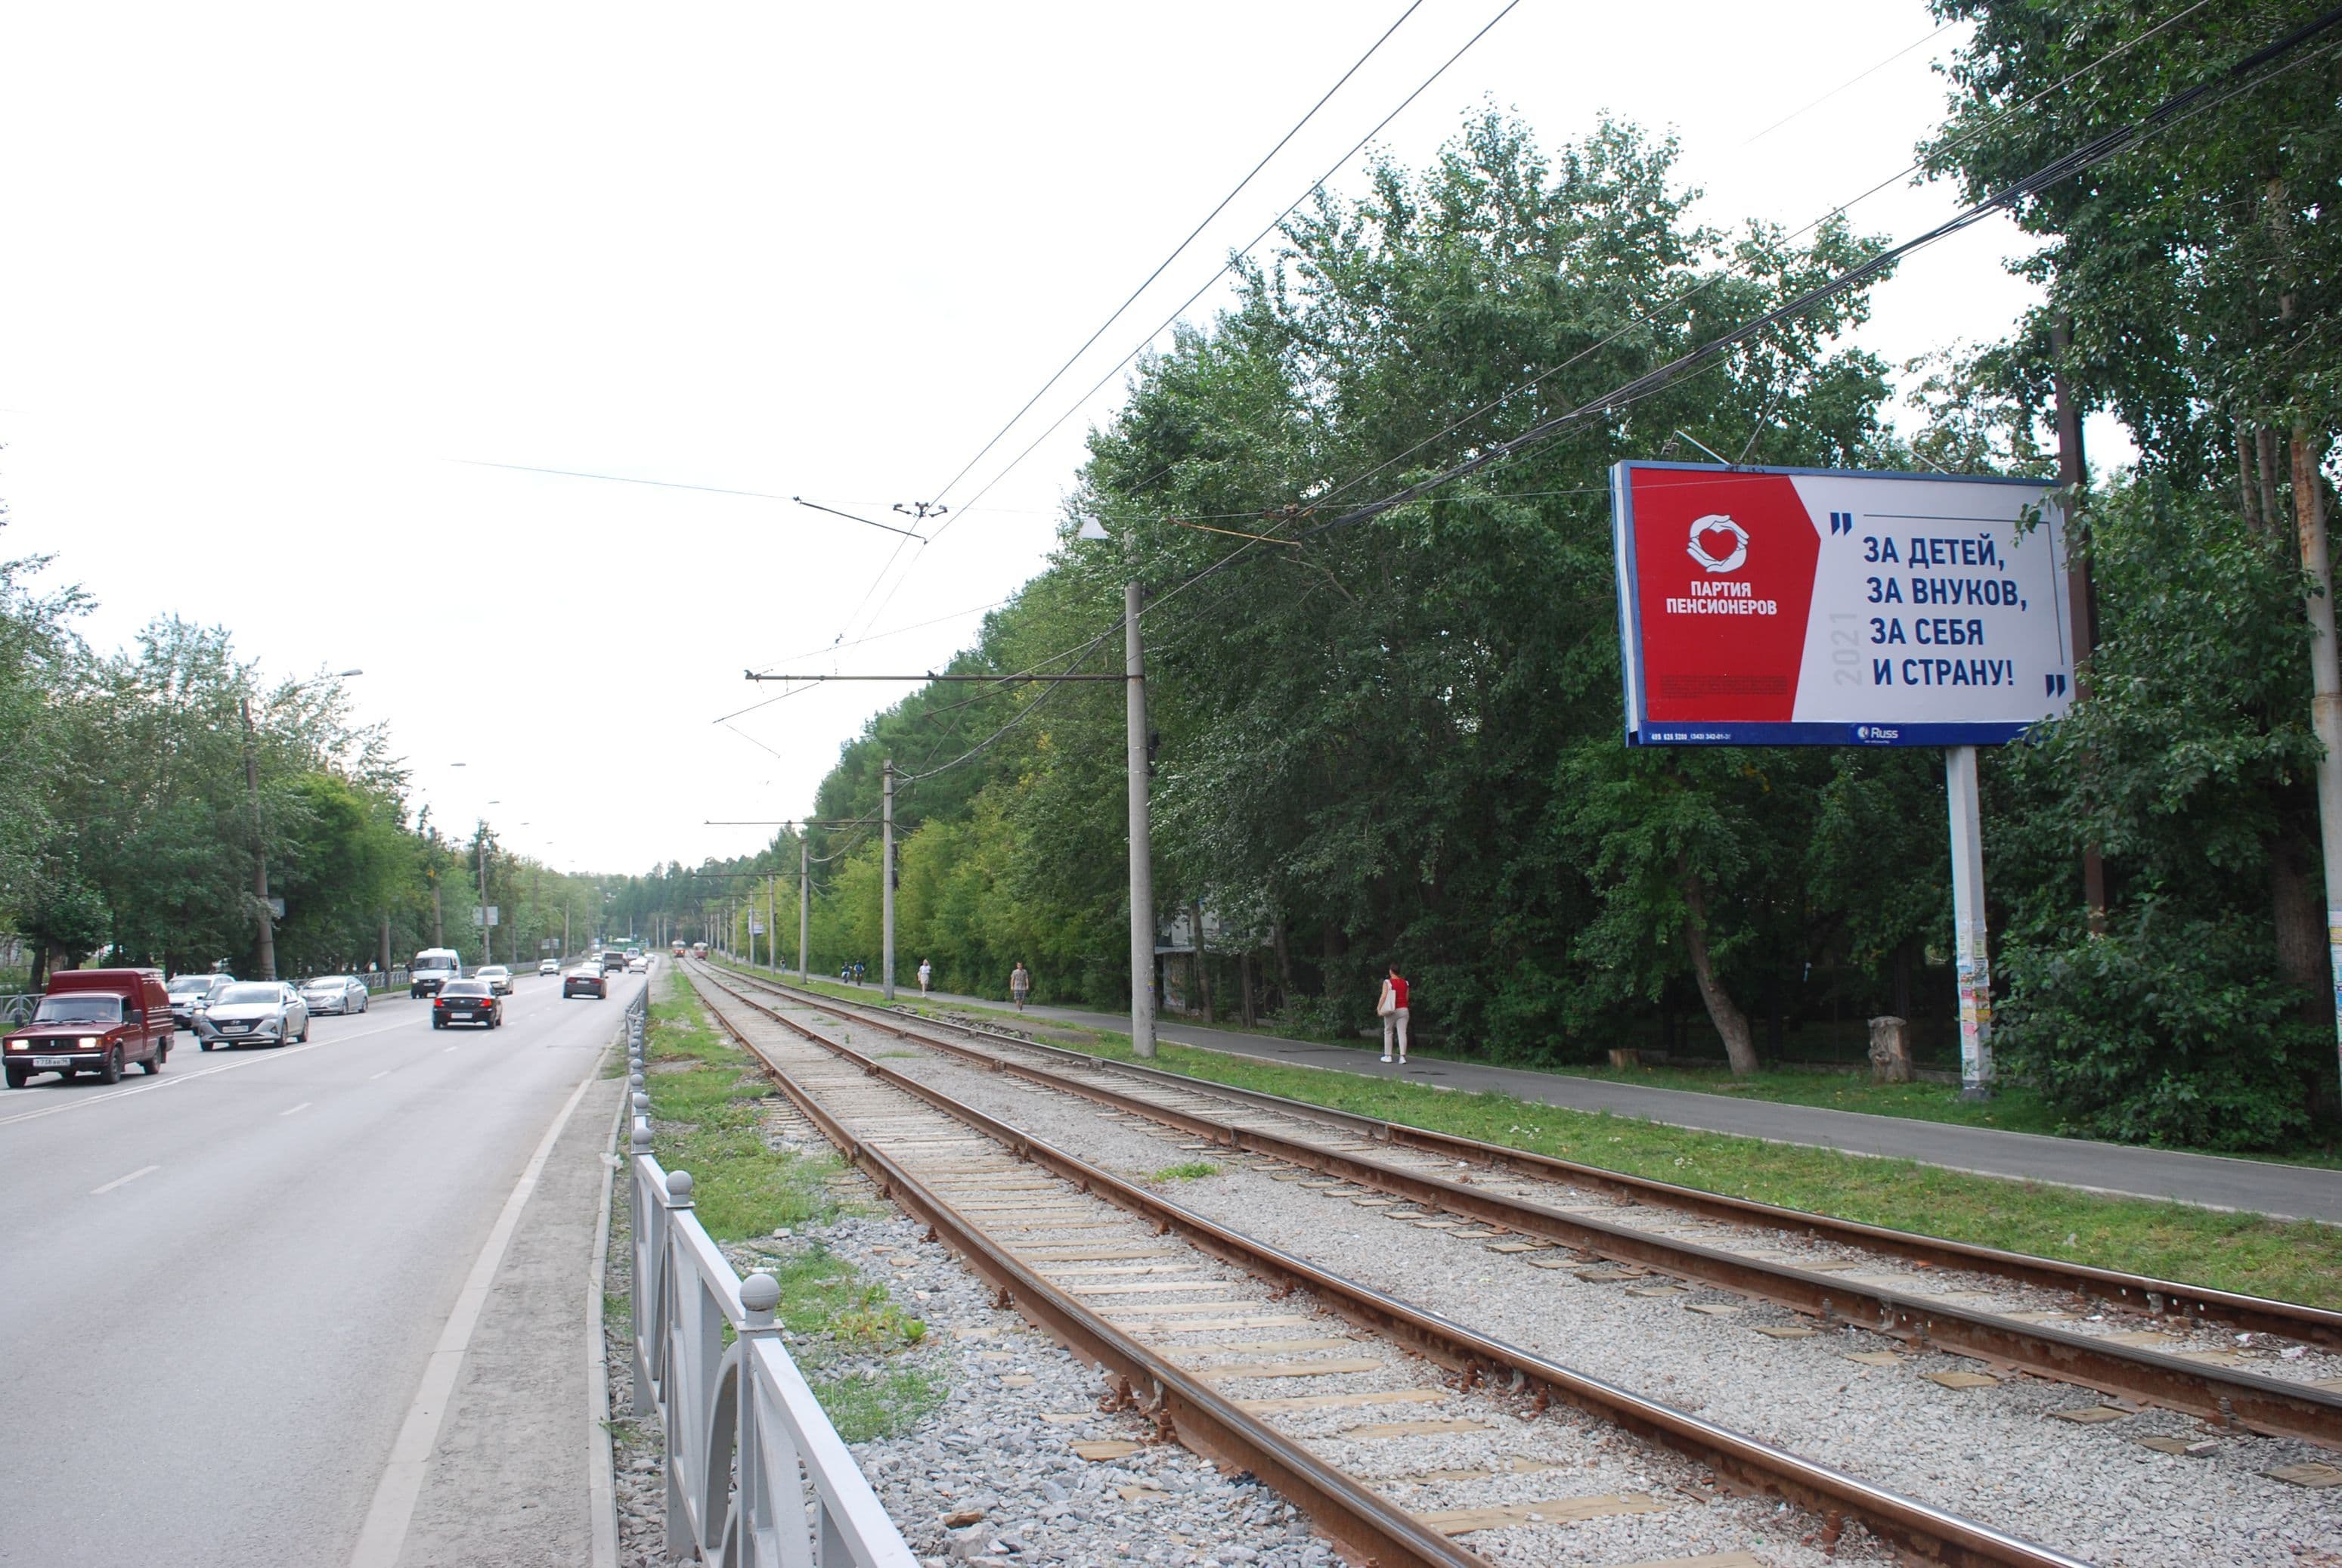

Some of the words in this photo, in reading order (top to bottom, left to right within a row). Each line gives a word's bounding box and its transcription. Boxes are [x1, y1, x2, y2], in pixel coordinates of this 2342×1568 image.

[1863, 536, 1899, 563] ЗА
[1908, 533, 2004, 571] ДЕТЕЙ,
[1690, 581, 1752, 597] ПАРТИЯ
[1866, 577, 1903, 603] ЗА
[1912, 578, 2027, 612] ВНУКОВ,
[1666, 598, 1777, 615] ПЕНСИОНЕРОВ
[1870, 618, 1906, 644] ЗА
[1915, 618, 1984, 645] СЕБЯ
[1829, 612, 1863, 686] 2021
[1873, 658, 1892, 685] И
[1902, 658, 2014, 686] СТРАНУ!
